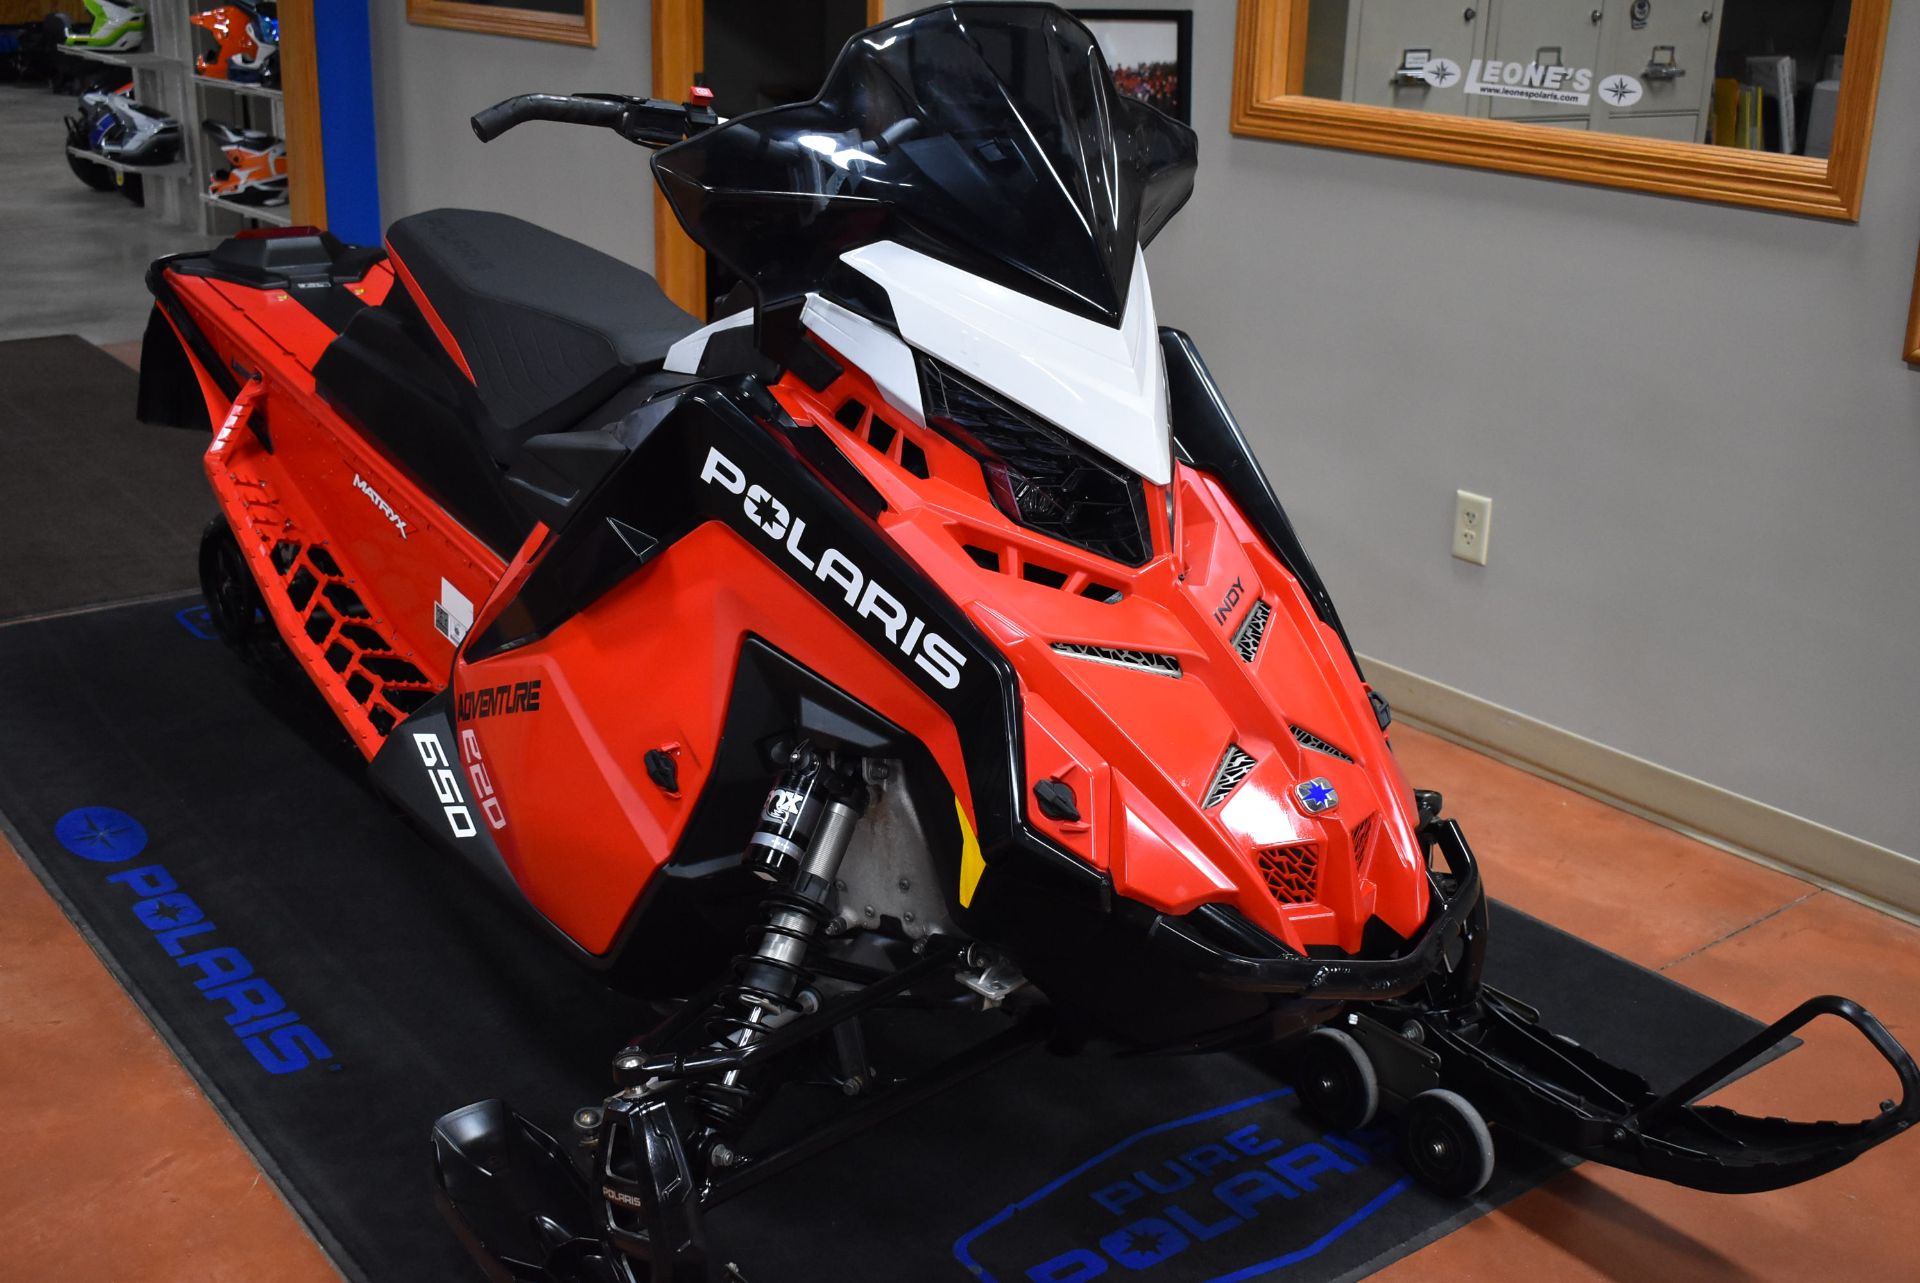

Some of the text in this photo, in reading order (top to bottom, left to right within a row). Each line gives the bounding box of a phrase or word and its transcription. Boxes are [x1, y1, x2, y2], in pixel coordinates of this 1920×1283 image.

[1464, 58, 1593, 94] LEONE'S
[1480, 86, 1579, 103] www.leonespolaris.com
[353, 473, 407, 539] MATRYX
[700, 446, 967, 689] POLARIS
[1213, 576, 1245, 626] INDY
[457, 680, 541, 722] ADVENTURE
[413, 733, 477, 838] 650
[105, 864, 333, 1075] POLARIS
[602, 1186, 641, 1207] POLARIS
[1090, 1123, 1285, 1215] PURE
[1024, 1131, 1390, 1283] POLARI
